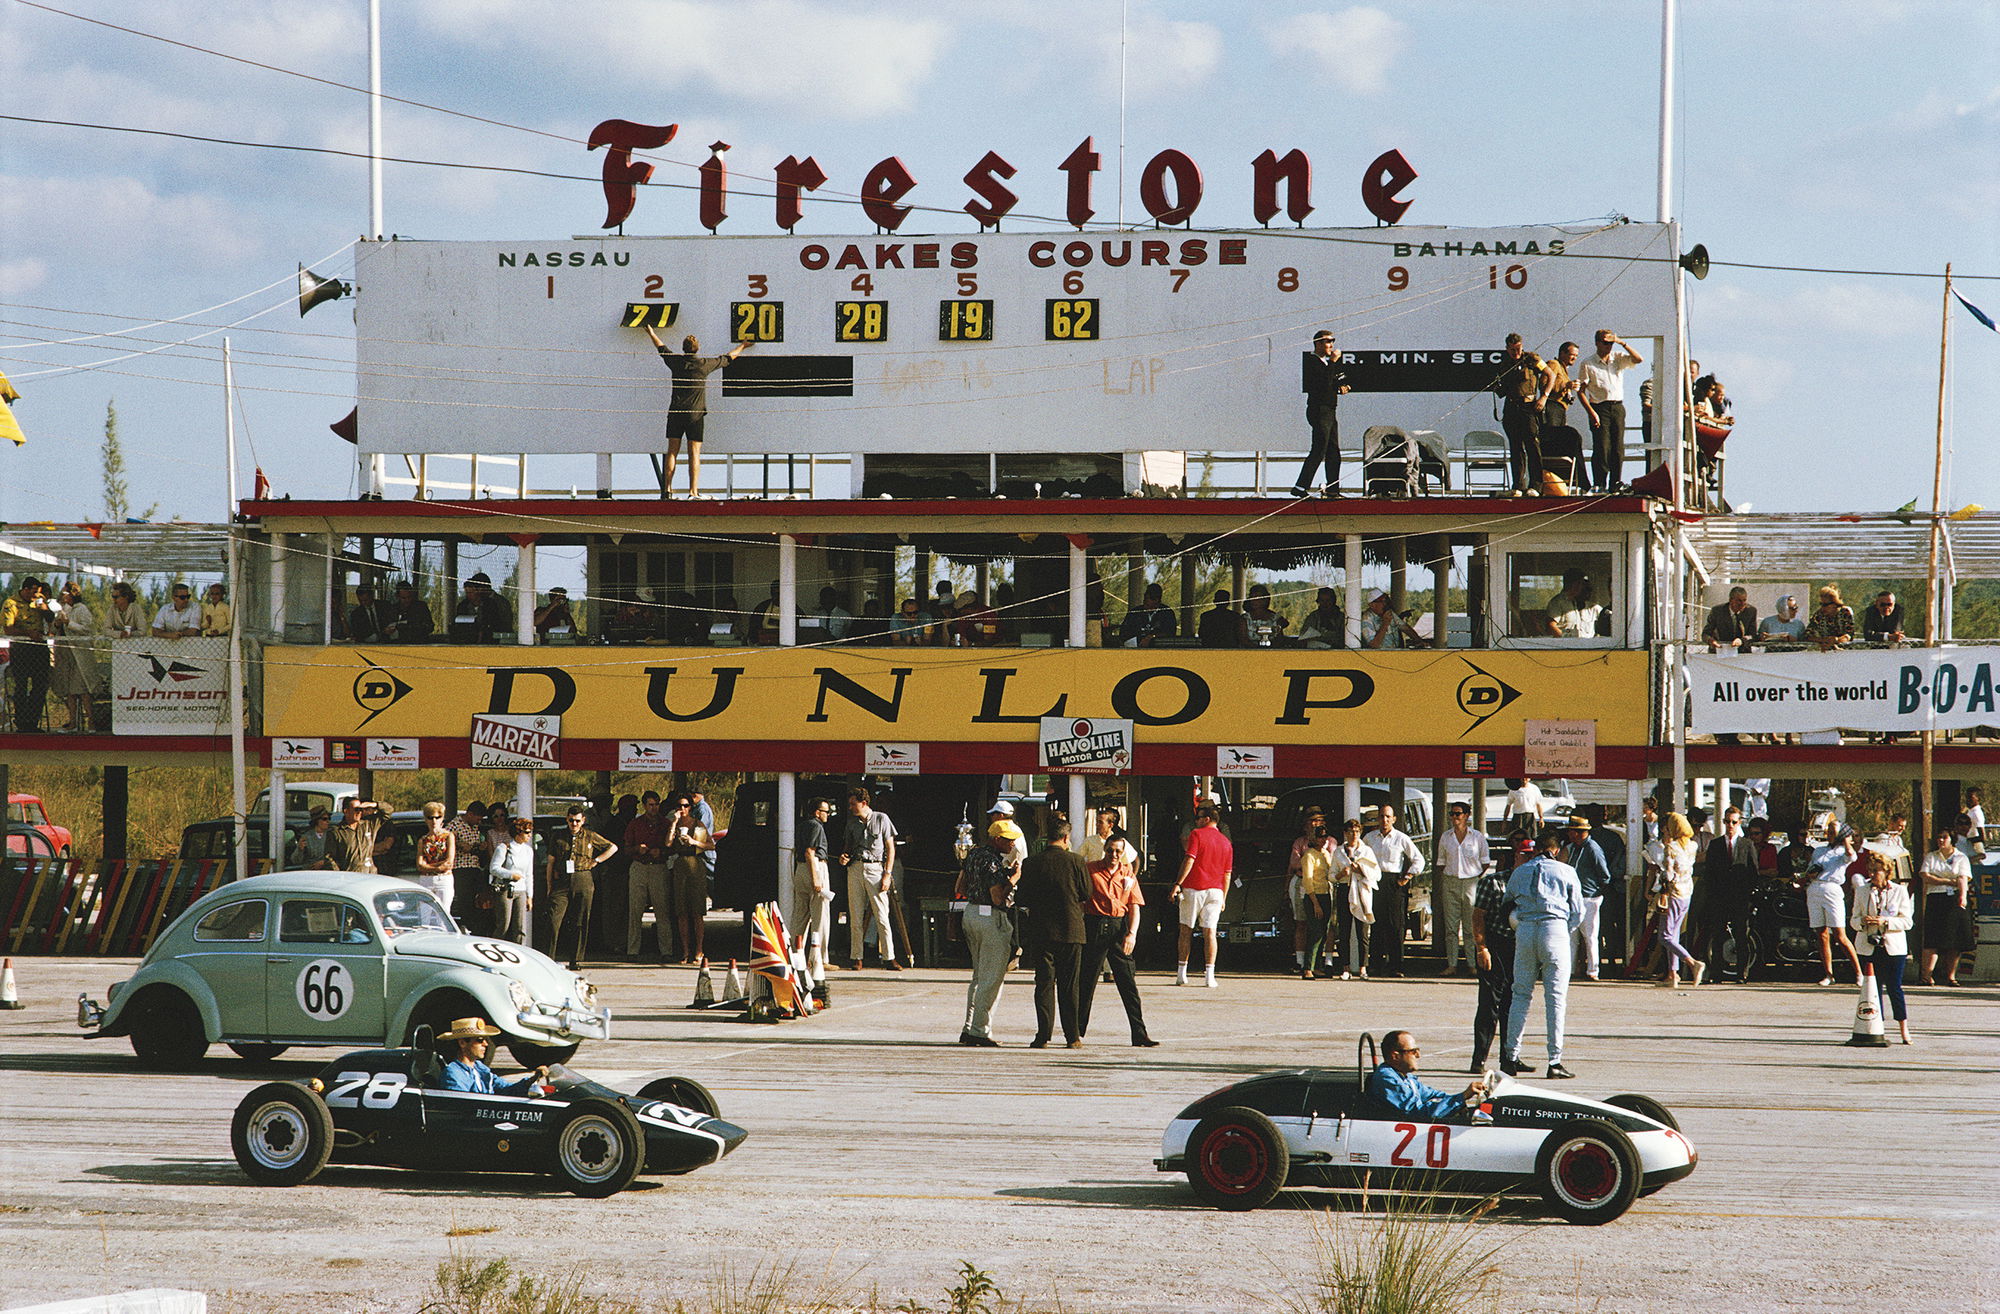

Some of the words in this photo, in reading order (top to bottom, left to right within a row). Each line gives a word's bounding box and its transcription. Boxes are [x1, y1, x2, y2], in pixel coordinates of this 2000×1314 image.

[587, 118, 1419, 230] Firestone
[498, 251, 631, 268] NASSAU
[799, 242, 978, 270] OAKES
[1028, 238, 1248, 268] COURSE
[1393, 239, 1567, 258] BAHAMAS
[547, 275, 554, 299] 1
[644, 274, 665, 299] 2
[747, 274, 768, 298] 3
[850, 273, 874, 297] 4
[956, 272, 978, 297] 5
[1062, 270, 1084, 296] 6
[1169, 269, 1191, 293] 7
[1276, 267, 1300, 292] 8
[1387, 266, 1410, 292] 9
[1489, 264, 1528, 290] 10
[628, 304, 672, 328] 71
[737, 303, 776, 341] 20
[842, 302, 882, 340] 28
[950, 302, 983, 339] 19
[1052, 301, 1092, 338] 62
[1379, 352, 1435, 364] MIN.
[1103, 357, 1166, 396] LAP
[117, 686, 228, 700] Johnson
[360, 682, 394, 699] D
[486, 665, 1375, 727] DUNLOP
[1466, 687, 1499, 705] D
[1713, 681, 1739, 702] All
[1745, 687, 1790, 702] over
[1795, 681, 1829, 701] the
[1834, 680, 1888, 700] world
[473, 720, 558, 760] MARFAK
[1047, 732, 1121, 758] HAVOLINE
[475, 752, 544, 768] Lubrication
[1061, 752, 1092, 765] MOTOR
[1096, 750, 1111, 759] OIL
[473, 943, 521, 964] 66
[303, 965, 344, 1016] 66
[325, 1071, 408, 1109] 28
[476, 1108, 511, 1120] BEACH
[514, 1110, 543, 1122] TEAM
[1501, 1106, 1531, 1117] FITCH
[1535, 1109, 1570, 1120] SPRINT
[1390, 1123, 1451, 1169] 20
